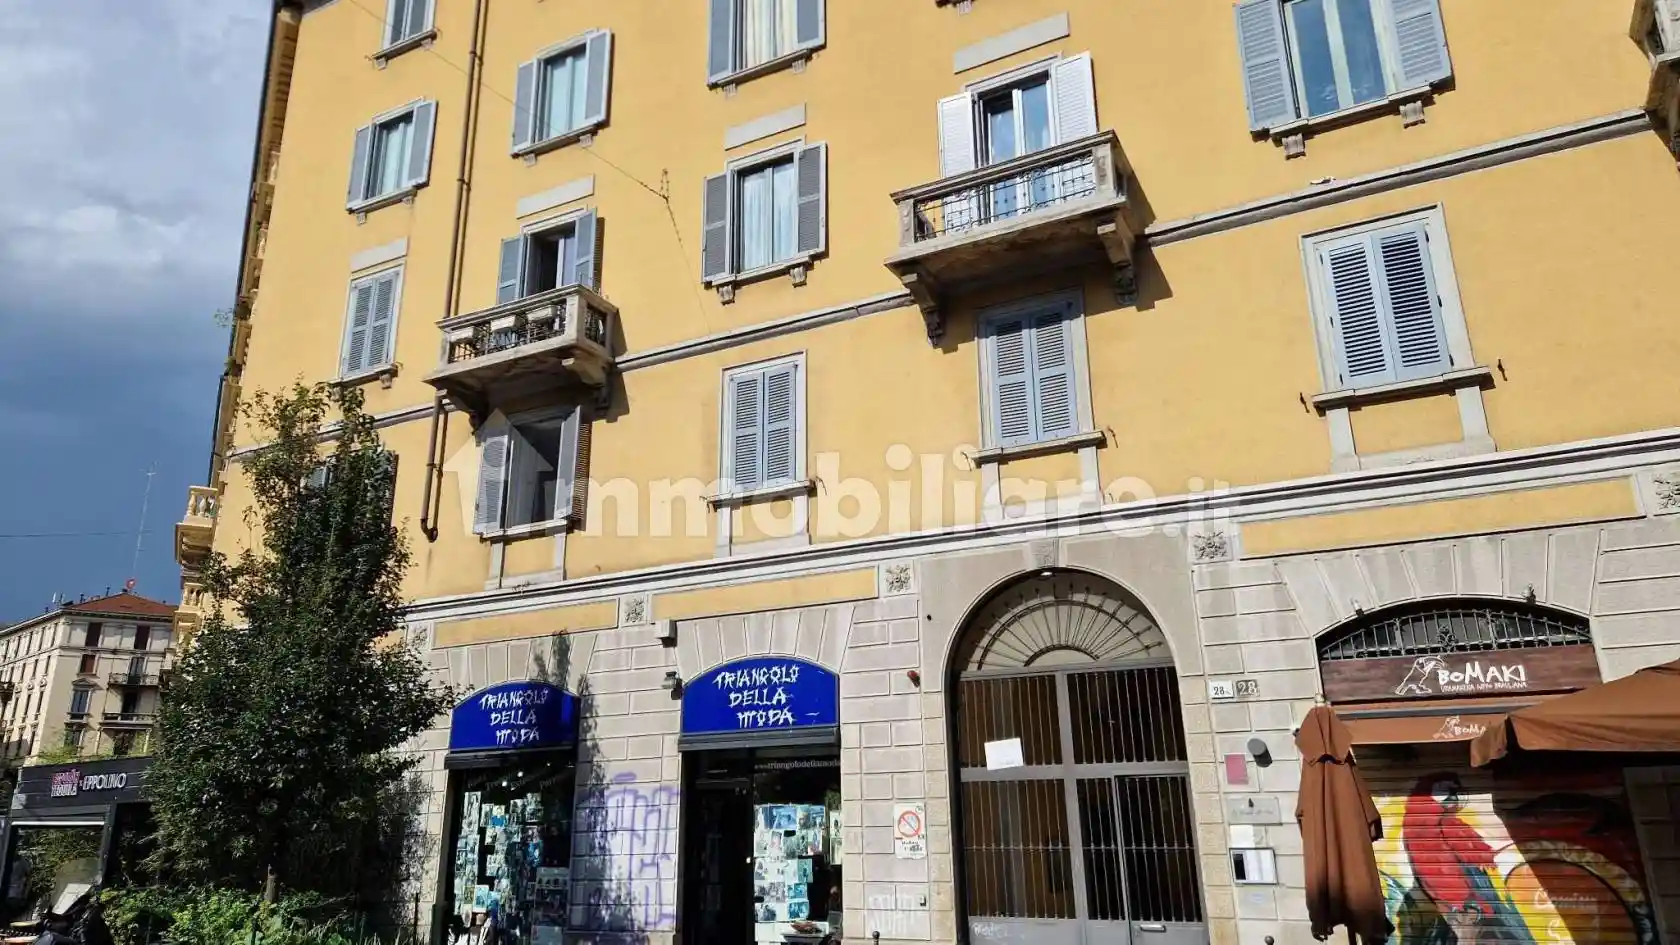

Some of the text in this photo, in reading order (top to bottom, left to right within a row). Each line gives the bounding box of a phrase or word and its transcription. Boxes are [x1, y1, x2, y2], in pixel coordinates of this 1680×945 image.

[712, 664, 800, 690] TRIANGOLO
[479, 688, 549, 710] TRIANGOLO
[728, 686, 788, 708] DELLA
[490, 708, 537, 726] DELLA
[736, 706, 798, 729] MODA
[495, 727, 540, 745] MODA
